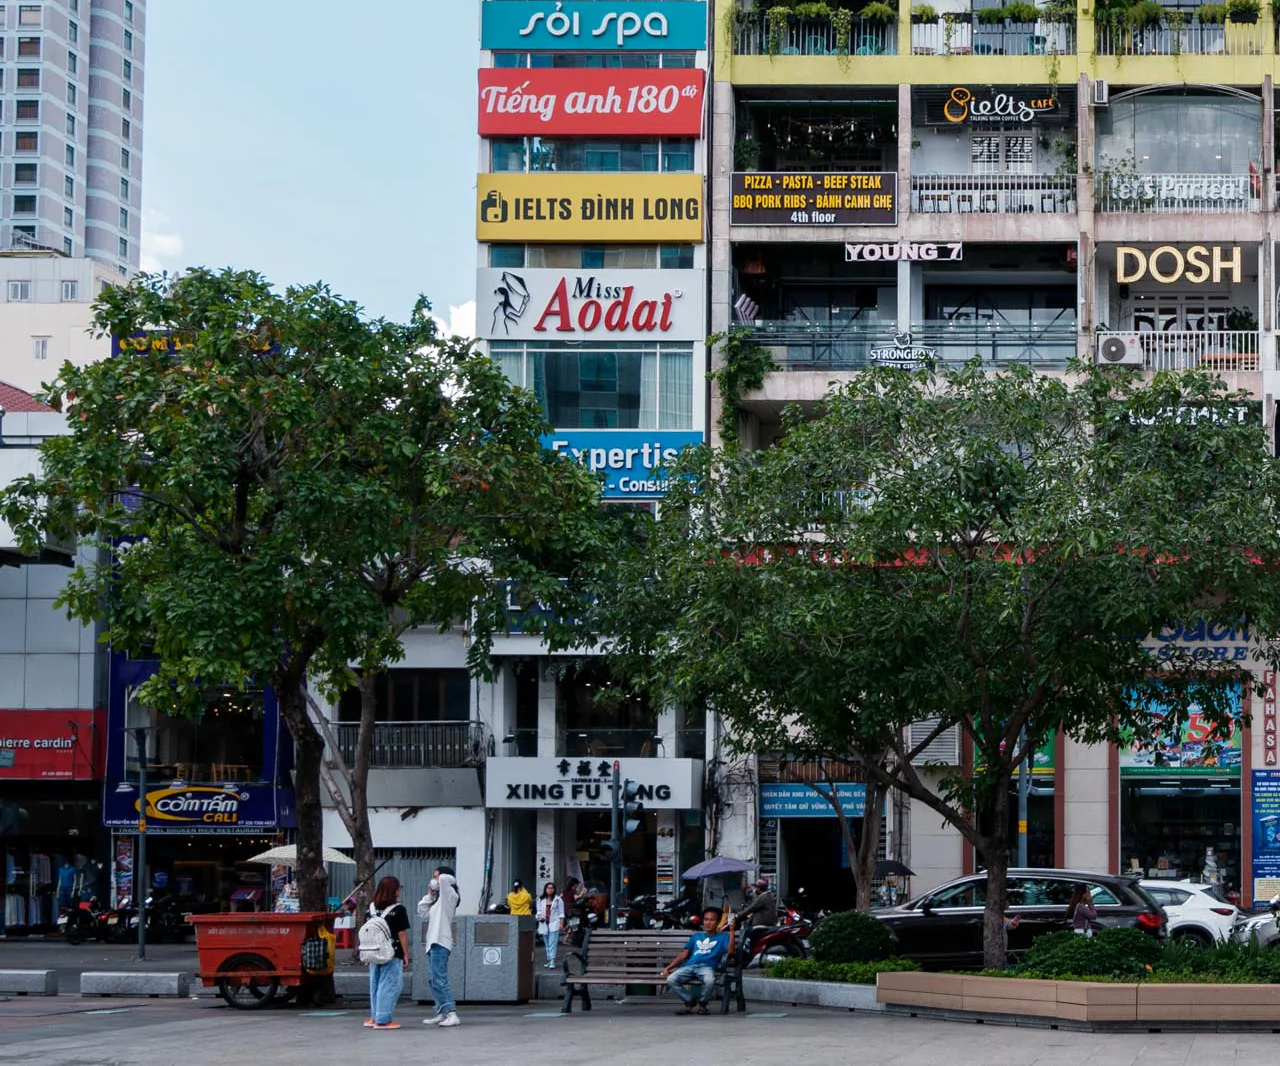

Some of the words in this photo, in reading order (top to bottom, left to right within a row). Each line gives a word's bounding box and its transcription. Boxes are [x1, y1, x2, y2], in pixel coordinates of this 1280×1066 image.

[592, 11, 668, 46] spa
[481, 81, 556, 121] Tiếng
[564, 86, 622, 114] anh
[626, 85, 679, 114] 180
[745, 175, 772, 189] PIZZA
[783, 175, 813, 189] PASTA
[824, 175, 848, 189] BEEF
[851, 175, 881, 189] STEAK
[514, 198, 572, 220] IELTS
[580, 194, 634, 220] ĐÌNH
[643, 198, 699, 220] LONG
[734, 194, 753, 209] BBQ
[755, 194, 781, 208] PORK
[784, 194, 806, 208] RIBS
[816, 192, 842, 208] BÁNH
[845, 194, 871, 208] CANH
[873, 194, 893, 211] GHẸ
[791, 211, 808, 223] 4th
[812, 211, 836, 223] floor
[847, 243, 938, 261] YOUNG
[946, 244, 962, 260] 7
[1116, 246, 1242, 283] DOSH
[572, 277, 623, 298] Miss
[533, 277, 674, 332] Aodai
[552, 440, 686, 472] Expertis
[1264, 671, 1277, 765] FAHASA
[34, 737, 72, 748] cardin
[506, 784, 564, 800] XING
[571, 784, 600, 800] FU
[203, 813, 237, 822] CALI
